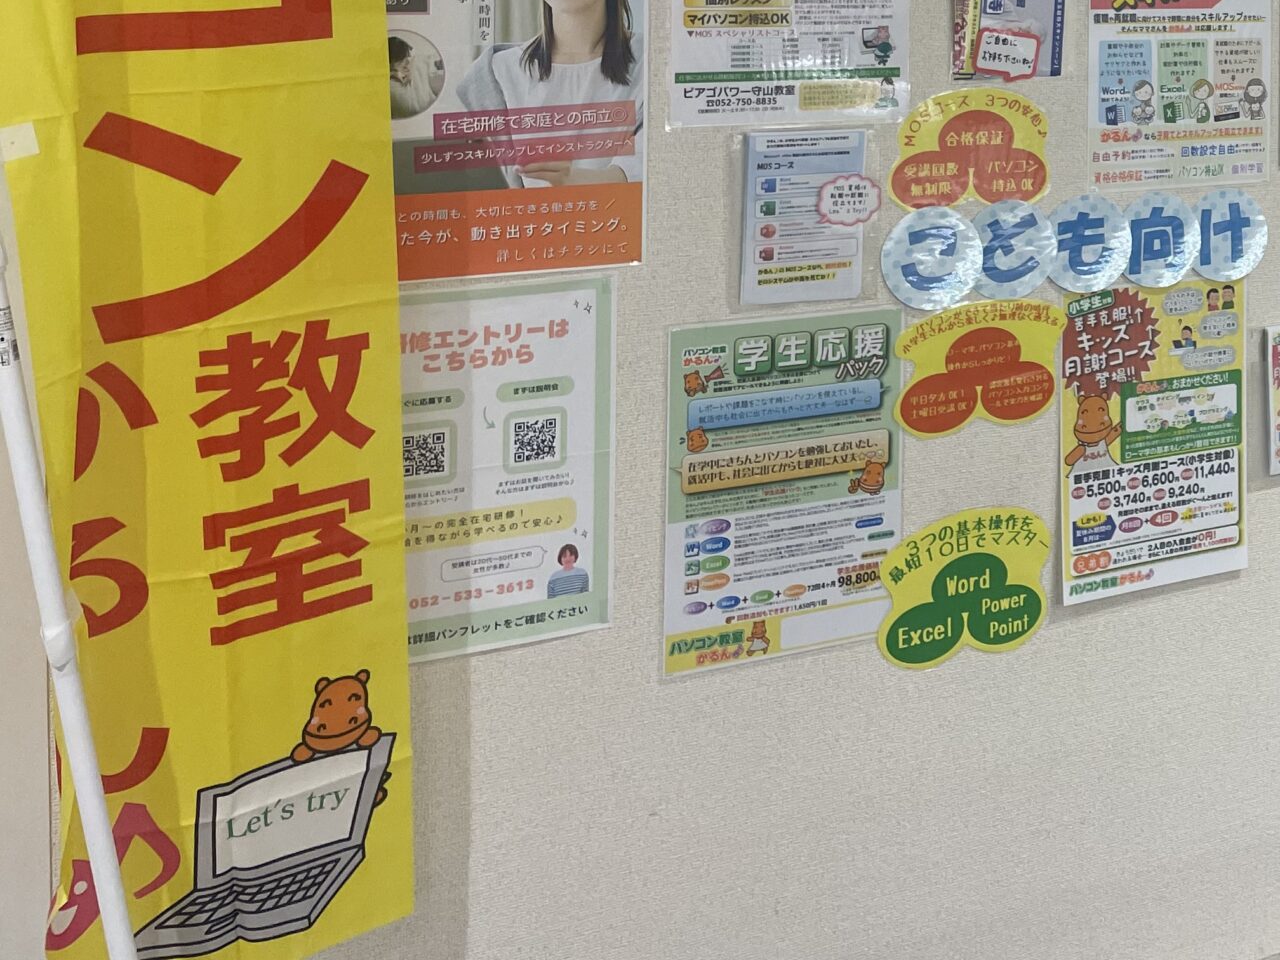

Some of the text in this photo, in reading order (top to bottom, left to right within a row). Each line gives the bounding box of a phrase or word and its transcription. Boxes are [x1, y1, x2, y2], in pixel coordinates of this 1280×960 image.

[1102, 86, 1126, 95] Word
[1160, 85, 1185, 93] Excel
[421, 138, 633, 164] 少しずつスキルアップしてインストラクターへ
[945, 130, 1005, 146] 合格保証
[904, 162, 959, 178] 受講回数
[987, 160, 1039, 174] パソコン
[910, 181, 951, 196] 無制限
[497, 241, 629, 263] 詳しくはチラシにて
[900, 202, 1251, 291] こども向け
[1077, 319, 1134, 352] キッズ
[422, 344, 535, 374] こちらから
[737, 326, 886, 372] 学生応援
[1065, 341, 1154, 377] 月謝コース
[835, 357, 885, 379] パック
[192, 318, 376, 646] 教室
[946, 568, 991, 597] Word
[982, 593, 1027, 615] Power
[897, 616, 952, 650] Excel
[989, 613, 1030, 639] Point
[669, 629, 745, 656] パソコン教室
[225, 781, 352, 845] Let's try
